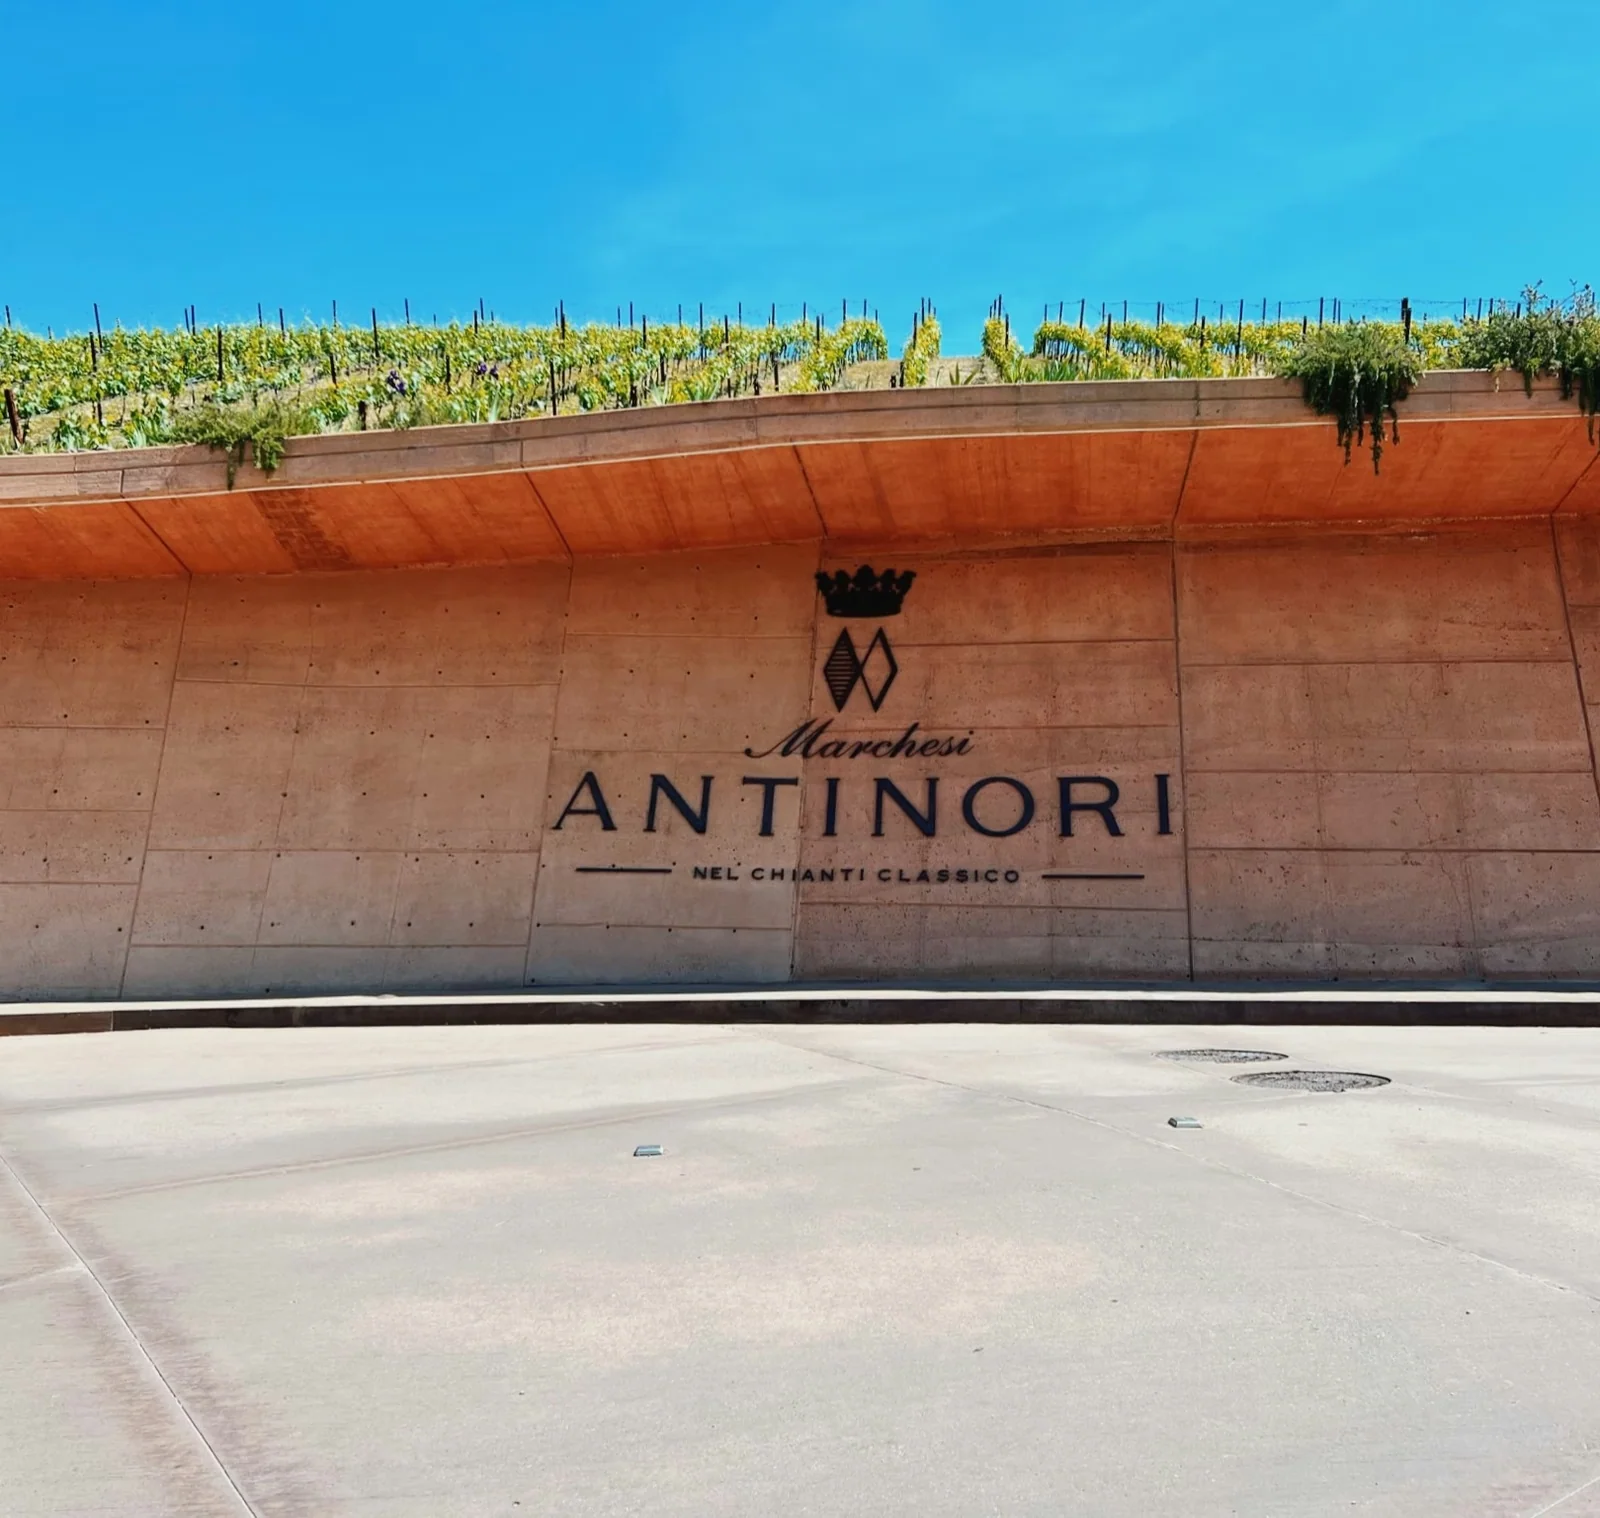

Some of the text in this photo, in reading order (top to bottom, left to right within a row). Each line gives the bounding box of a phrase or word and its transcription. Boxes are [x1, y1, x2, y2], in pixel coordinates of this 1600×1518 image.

[743, 718, 975, 760] Marchesi
[550, 770, 1175, 839] ANTINORI
[692, 865, 1022, 885] NEL CHIANTI CLASSICO
